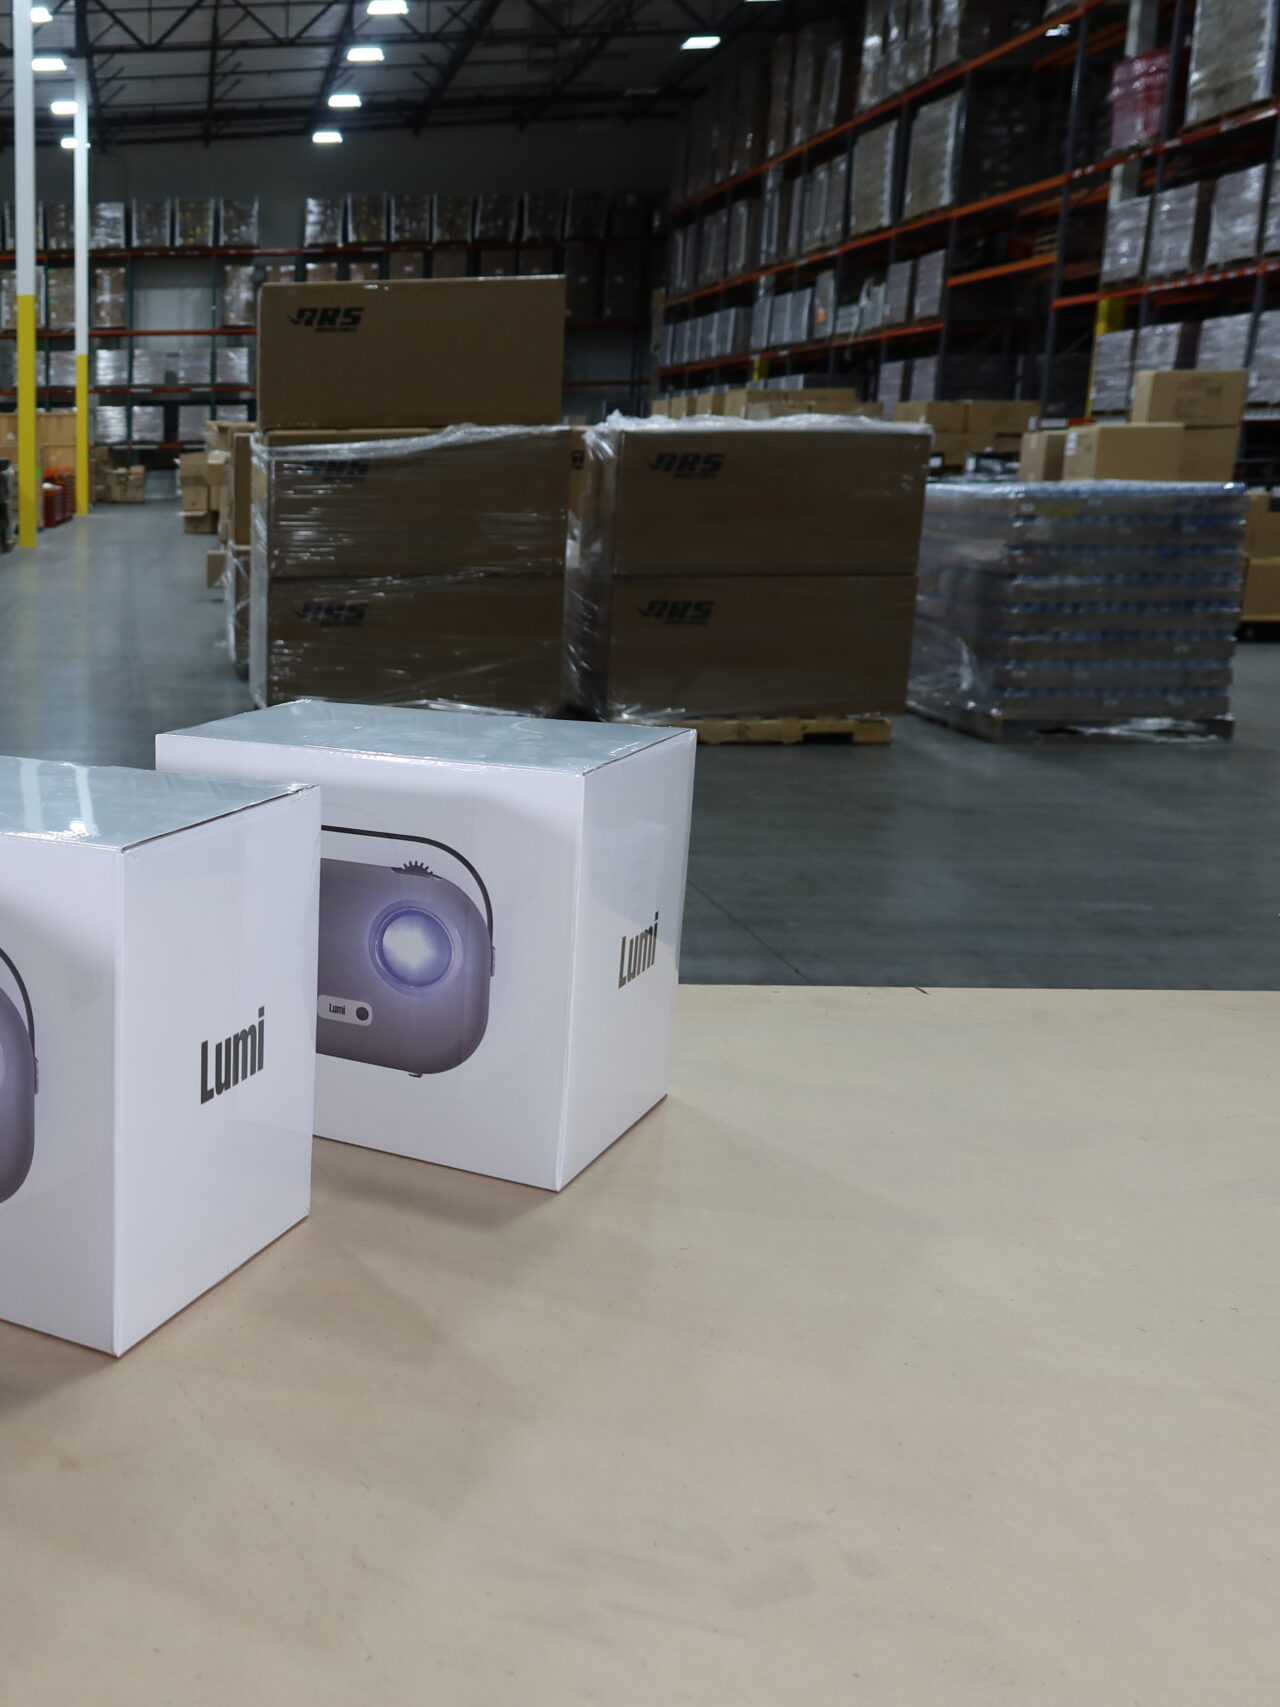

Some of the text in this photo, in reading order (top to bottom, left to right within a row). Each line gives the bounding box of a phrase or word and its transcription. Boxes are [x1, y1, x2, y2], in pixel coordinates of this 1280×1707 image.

[618, 911, 659, 989] Lumi
[328, 1003, 346, 1015] Lumi
[201, 1006, 264, 1105] Lumi
